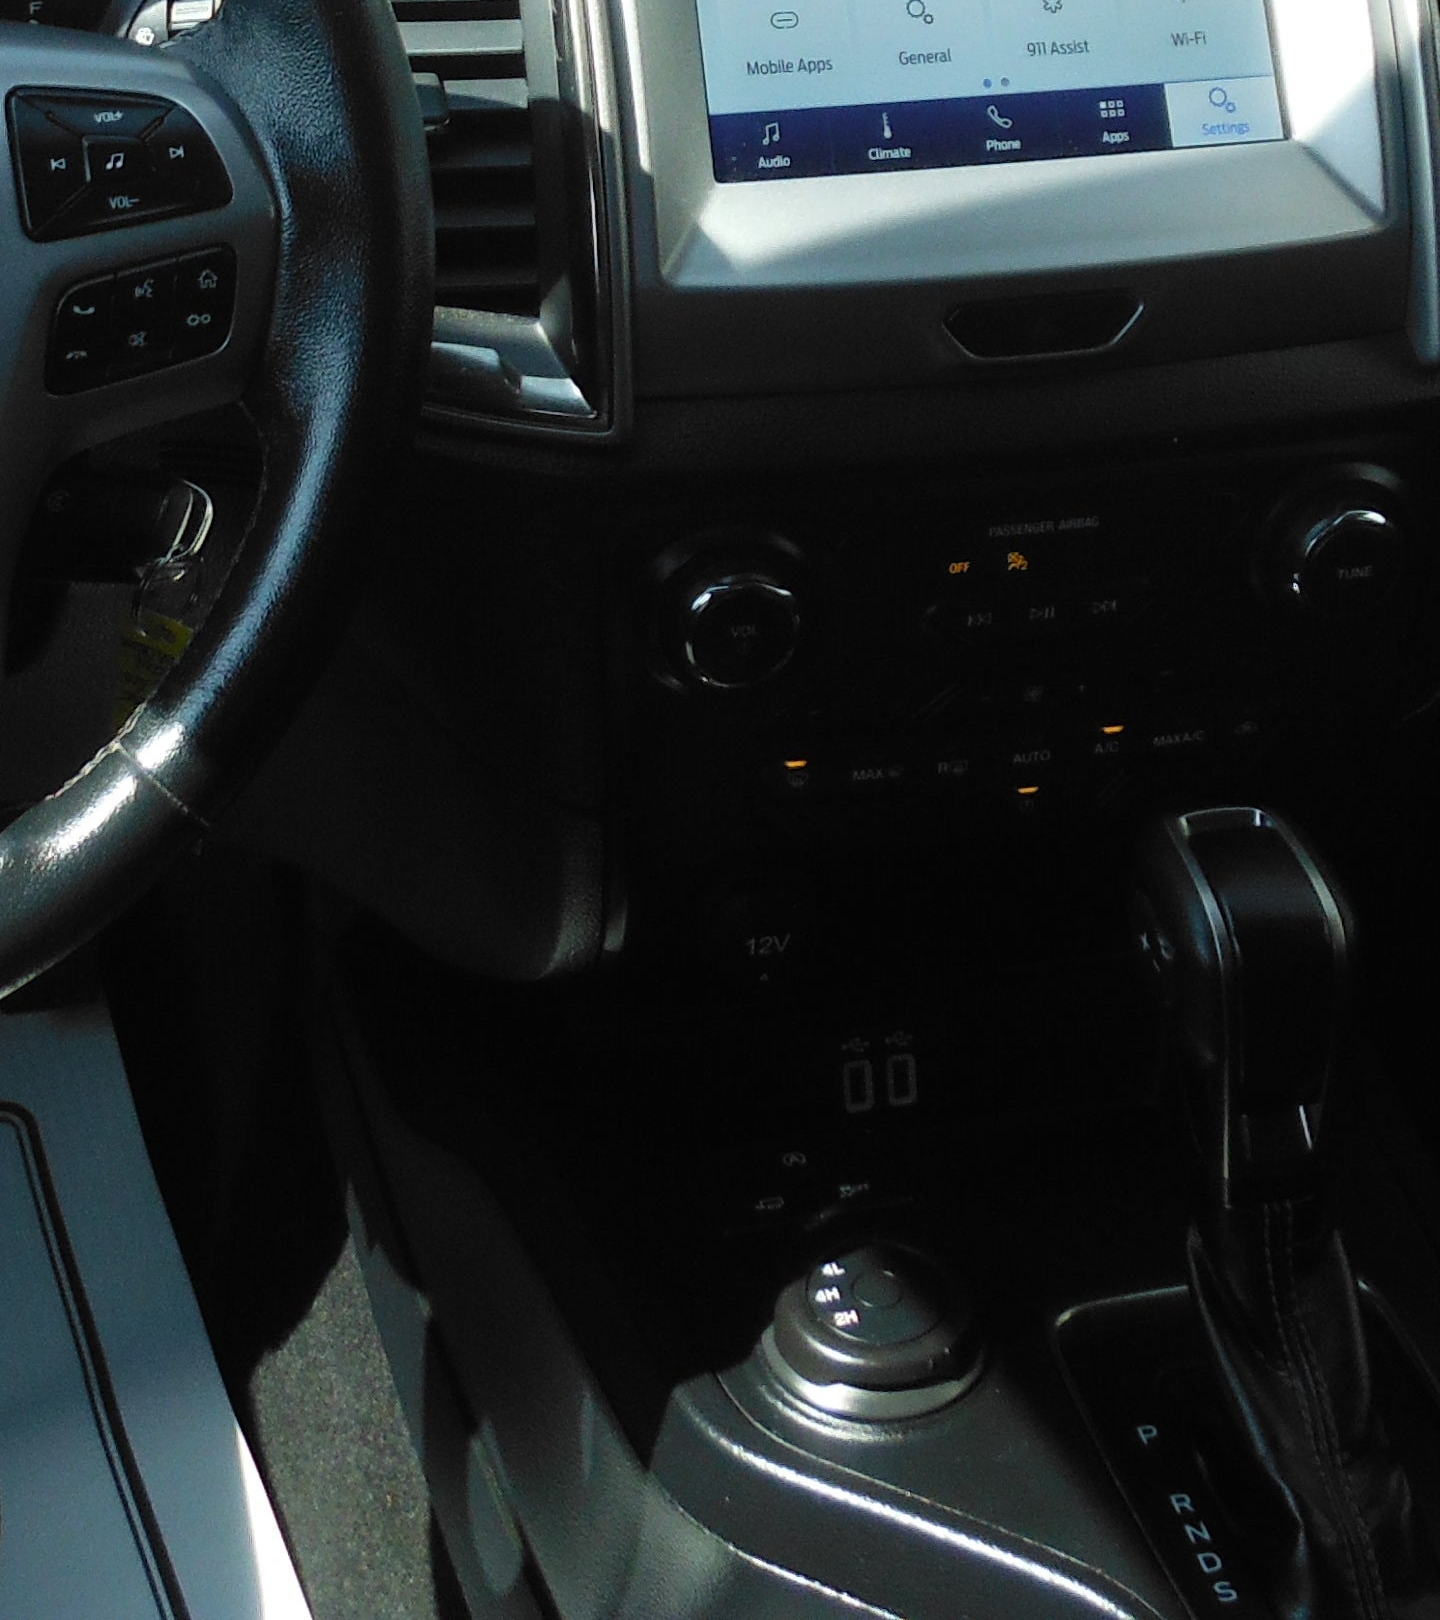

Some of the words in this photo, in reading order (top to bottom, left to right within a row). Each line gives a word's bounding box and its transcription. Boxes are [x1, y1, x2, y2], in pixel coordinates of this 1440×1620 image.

[29, 1, 43, 14] F
[1171, 31, 1208, 47] Wi-Fi
[1027, 41, 1047, 57] 911
[1050, 39, 1090, 55] Assist
[898, 48, 952, 66] General
[747, 59, 794, 75] Mobile
[797, 58, 833, 75] Apps
[1101, 130, 1130, 145] Apps
[1202, 122, 1250, 137] Settings
[985, 138, 1022, 151] Phone
[758, 155, 791, 169] Audio
[868, 147, 912, 161] Climate
[988, 520, 1055, 538] PASSENGER
[1058, 515, 1100, 531] AIRBAG
[948, 560, 971, 575] OFF
[1337, 565, 1373, 580] TUNE
[1094, 740, 1121, 755] A/C
[1012, 749, 1052, 764] AUTO
[853, 768, 885, 781] MAX
[745, 932, 792, 956] 12V
[822, 1261, 846, 1276] 4L
[815, 1286, 840, 1303] 4H
[833, 1309, 859, 1327] 2H
[1137, 1424, 1158, 1445] P
[1169, 1493, 1195, 1515] R
[1183, 1522, 1211, 1544] N
[1196, 1551, 1223, 1574] D
[1212, 1580, 1239, 1602] S
